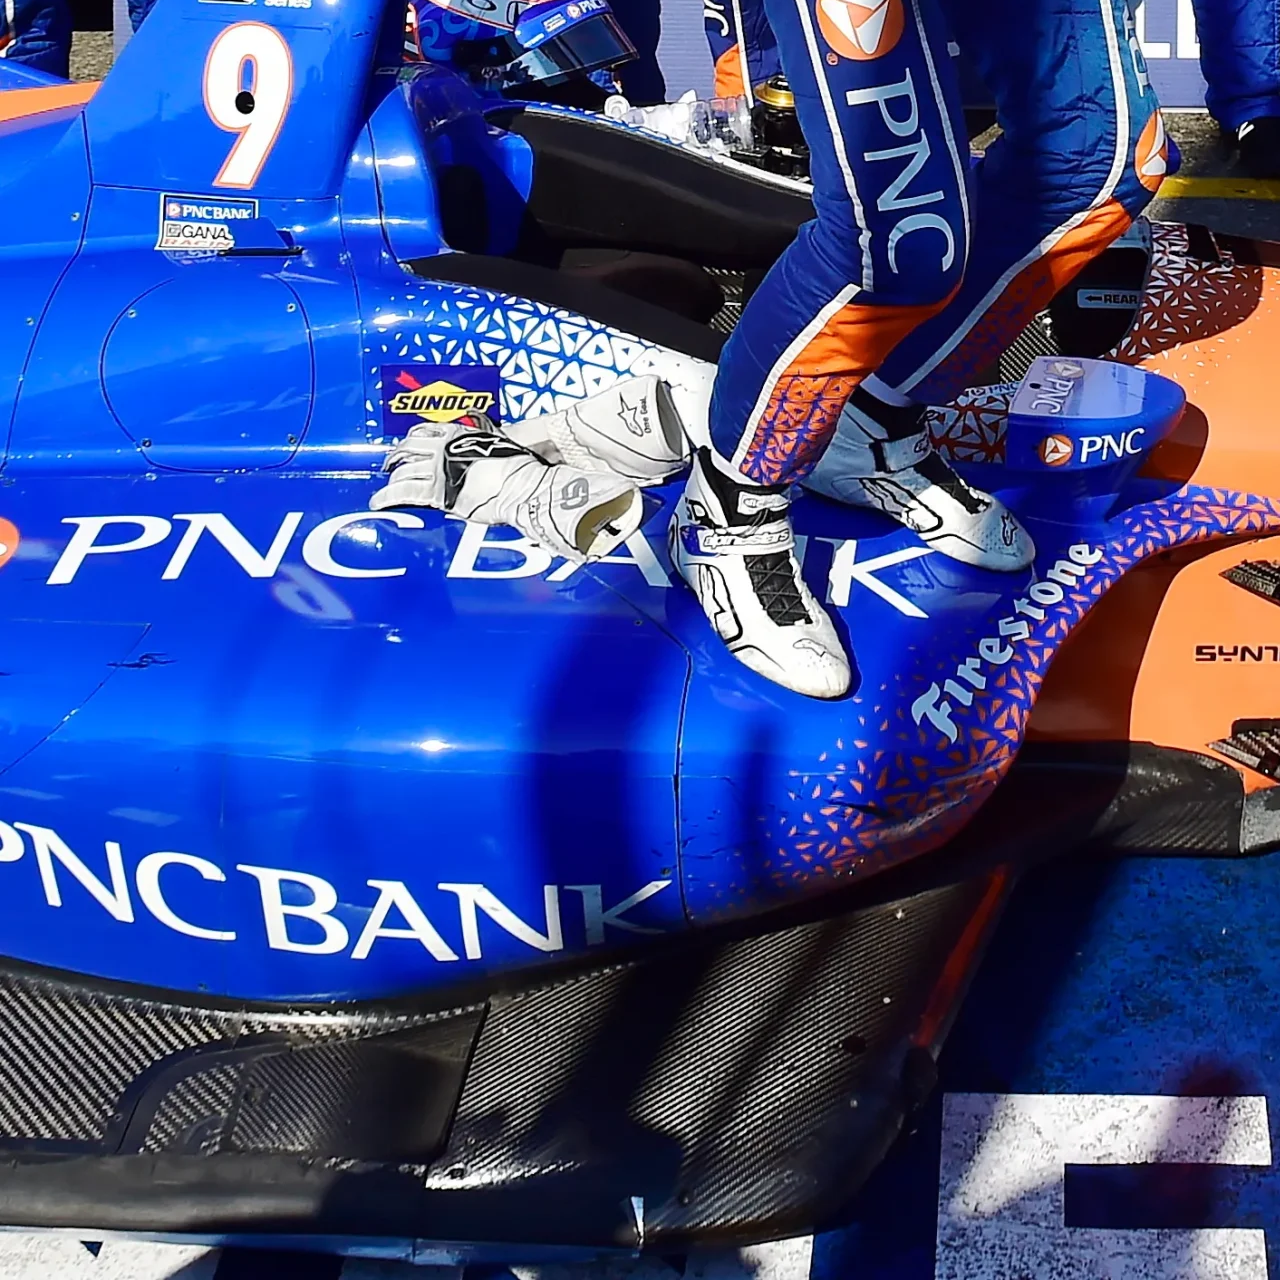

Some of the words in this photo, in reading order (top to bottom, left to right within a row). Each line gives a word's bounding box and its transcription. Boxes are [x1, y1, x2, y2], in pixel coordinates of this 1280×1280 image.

[203, 20, 294, 189] 9
[845, 67, 955, 277] PNC
[182, 205, 252, 220] PNCBANK
[182, 224, 230, 240] GANA
[1104, 293, 1138, 306] REAR
[394, 394, 488, 411] SUNOCO
[1079, 427, 1146, 464] PNC
[45, 511, 408, 585] PNC
[911, 542, 1104, 744] Firestone
